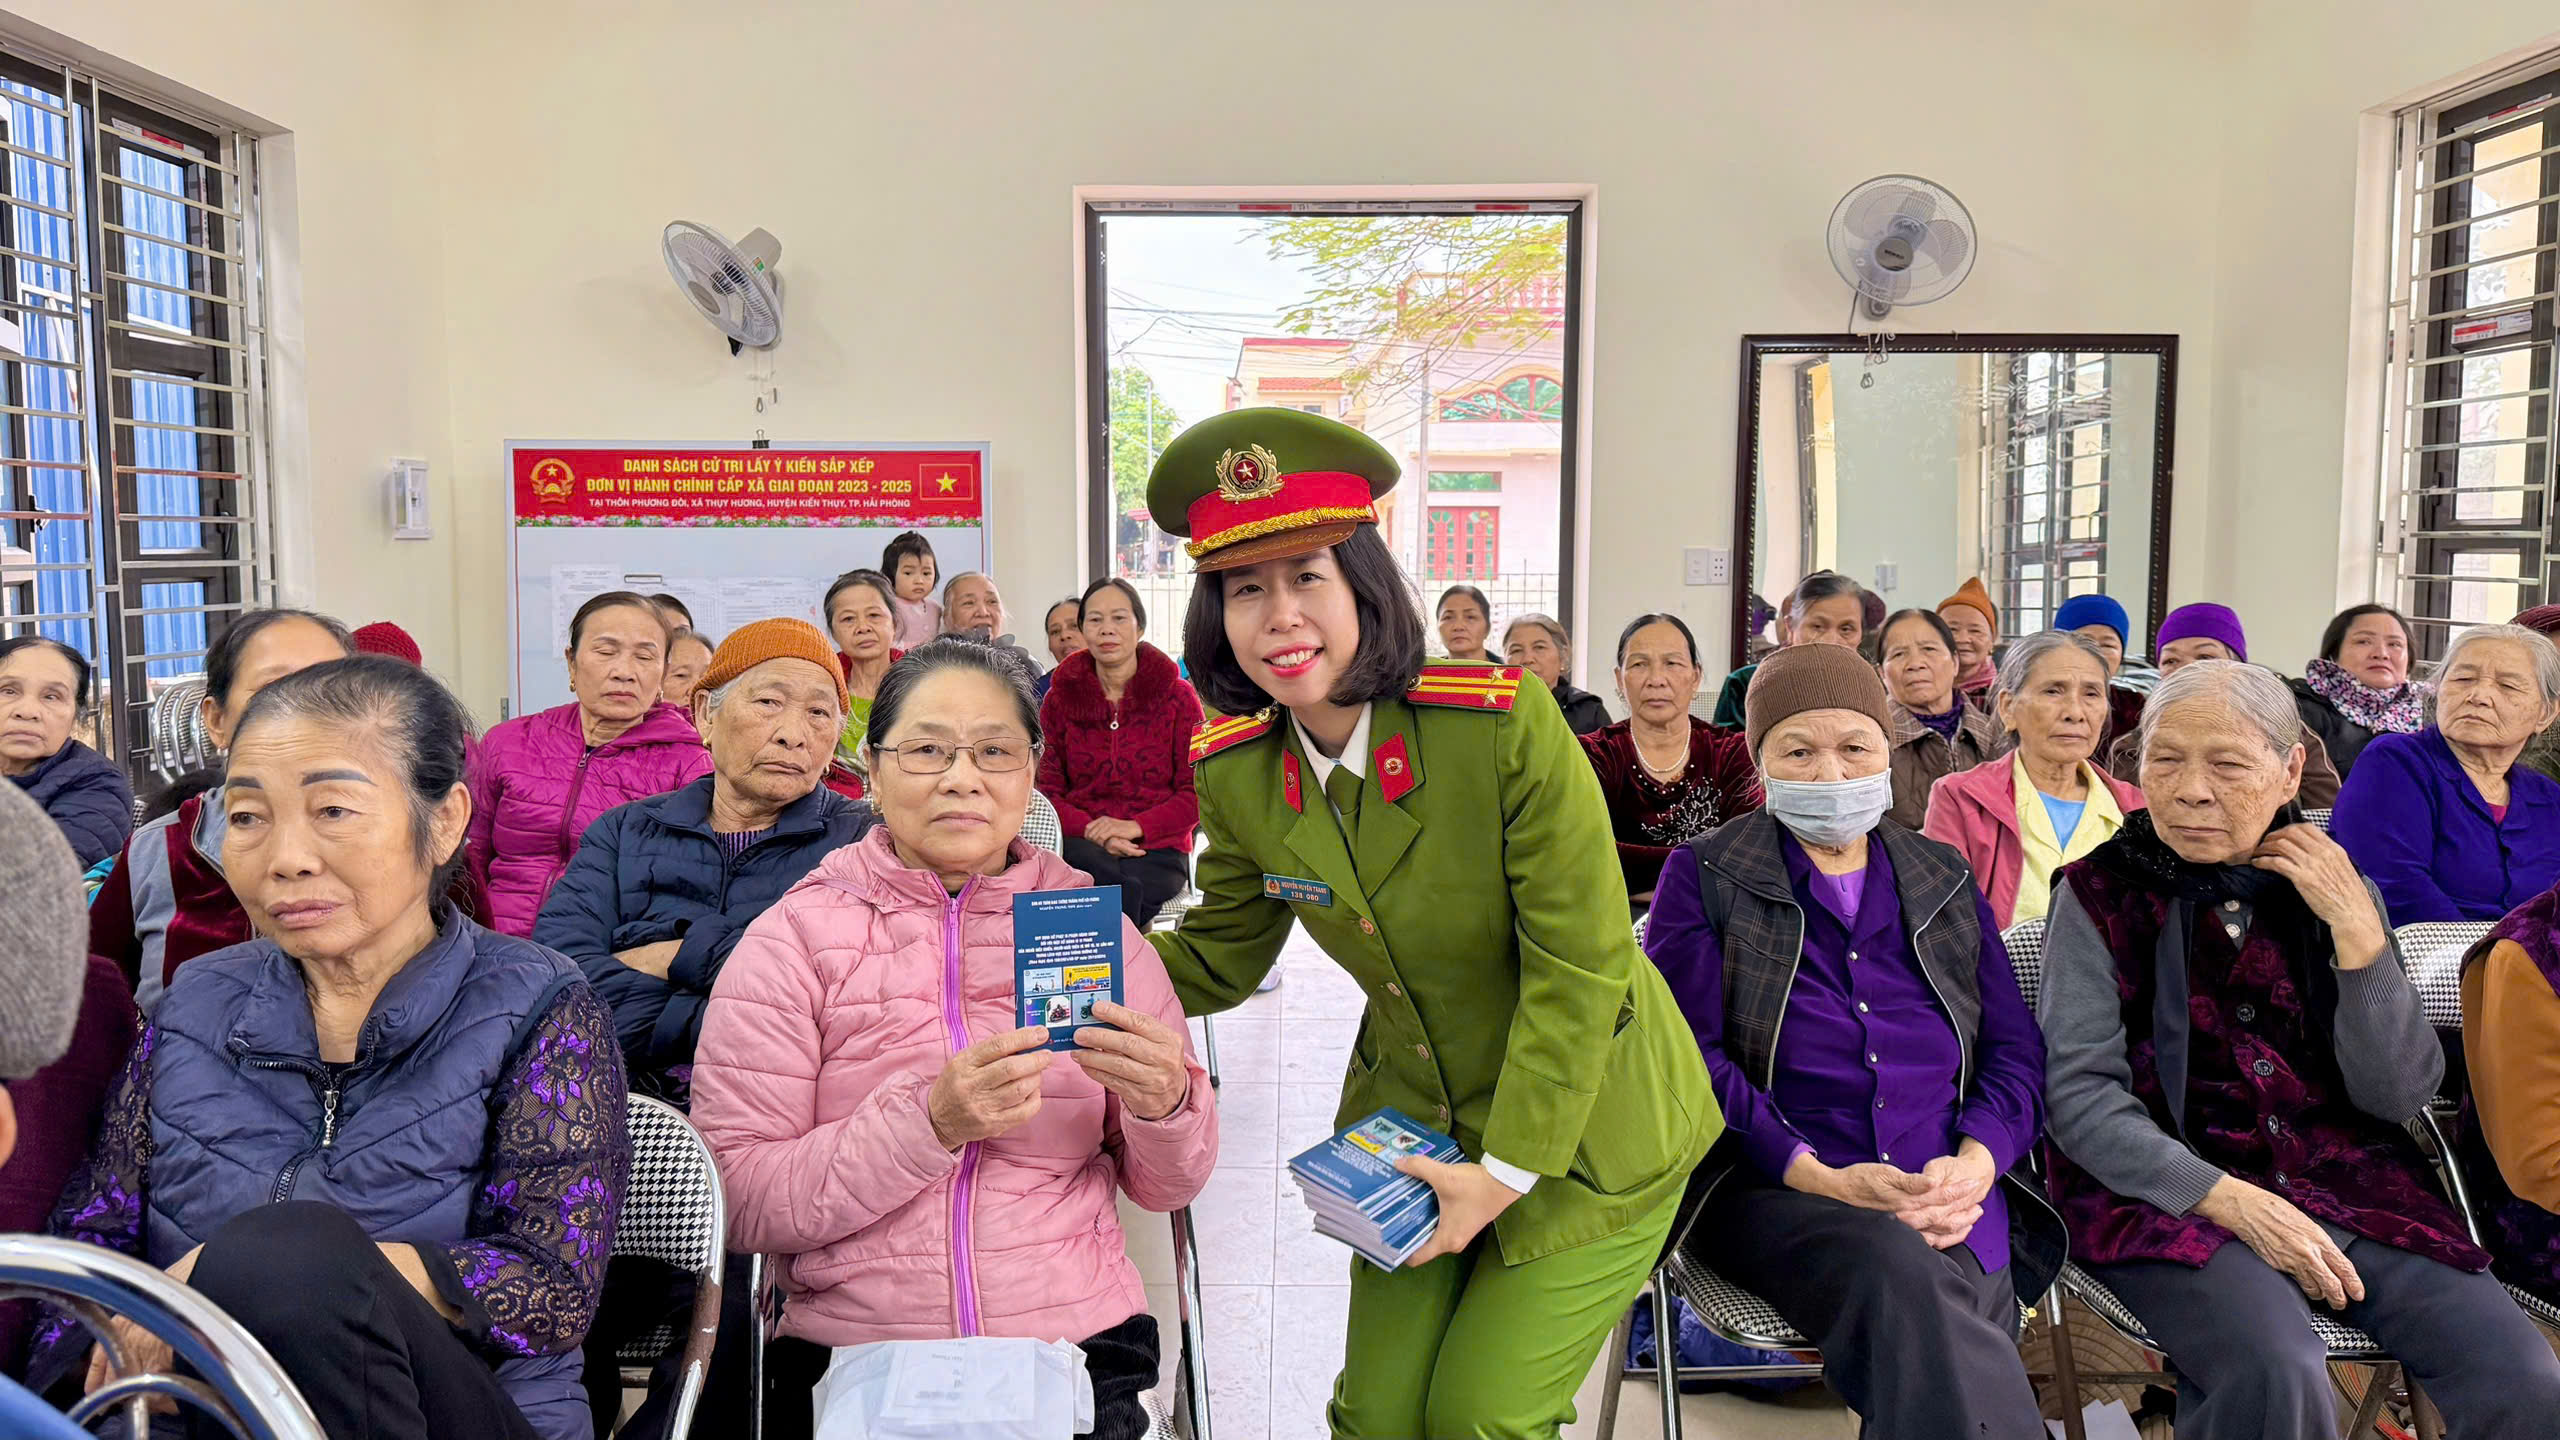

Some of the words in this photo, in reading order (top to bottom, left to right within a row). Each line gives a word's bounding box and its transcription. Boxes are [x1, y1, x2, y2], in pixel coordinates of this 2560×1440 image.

[624, 458, 660, 472] DANH
[663, 456, 699, 472] SÁCH
[701, 455, 721, 472] CỬ
[722, 459, 744, 472] TRI
[747, 455, 772, 472] LẤY
[786, 456, 817, 472] KIẾN
[849, 456, 876, 472] XẾP
[587, 478, 615, 492] ĐƠN
[616, 479, 631, 495] VỊ
[633, 476, 671, 492] HÀNH
[673, 476, 714, 492] CHÍNH
[717, 475, 745, 492] CẤP
[747, 477, 766, 492] XÃ
[767, 479, 795, 492] GIAI
[798, 479, 835, 495] ĐOẠN
[837, 479, 869, 492] 2023
[880, 479, 913, 492] 2025
[589, 499, 604, 509] TẠI
[606, 497, 630, 508] THÔN
[631, 499, 669, 508] PHƯƠNG
[691, 497, 704, 508] XÃ
[704, 499, 729, 510] THỤY
[767, 497, 798, 510] HUYỆN
[798, 497, 821, 508] KIẾN
[848, 499, 862, 508] TP.
[862, 497, 878, 508] HẢI
[879, 497, 911, 508] PHÒNG
